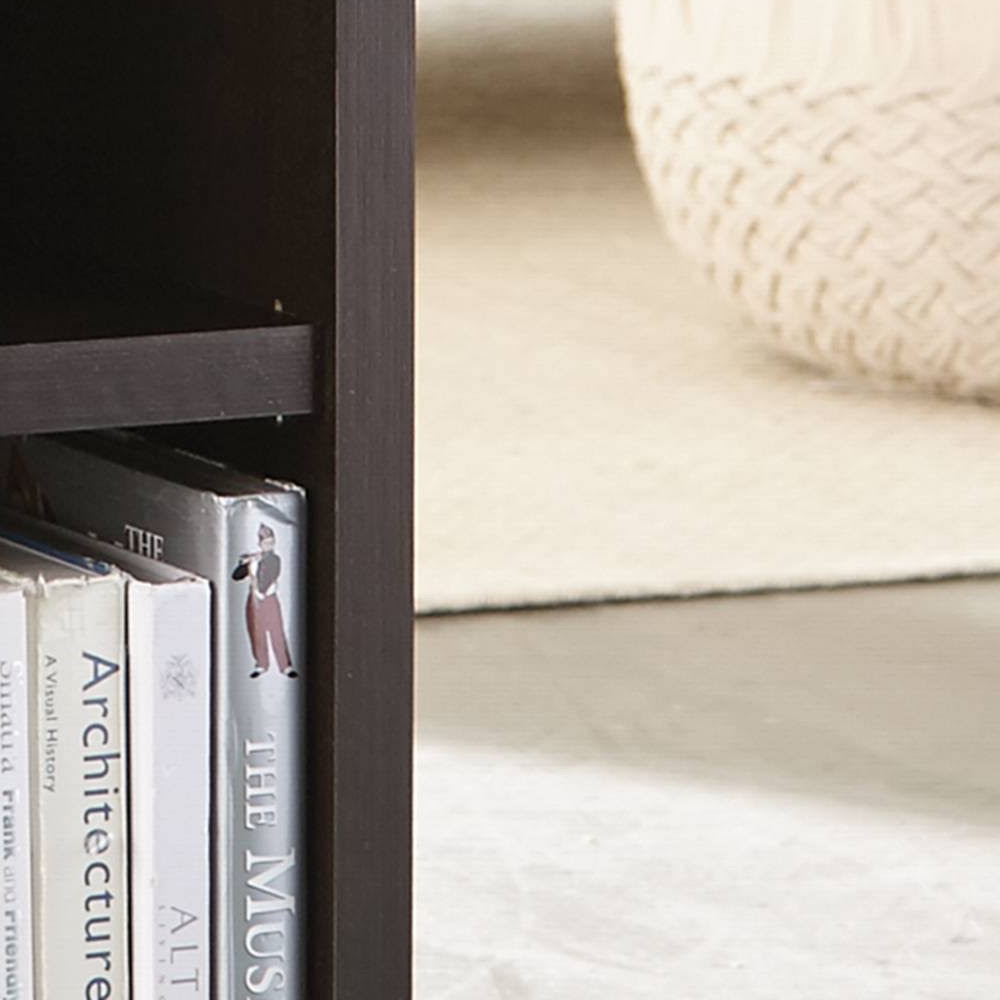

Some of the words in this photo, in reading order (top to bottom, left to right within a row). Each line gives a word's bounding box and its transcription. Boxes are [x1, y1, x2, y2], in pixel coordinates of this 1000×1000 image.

[124, 524, 165, 561] THE
[44, 673, 58, 722] Visual
[45, 655, 57, 667] A
[43, 729, 58, 793] History
[242, 732, 279, 831] THE
[81, 651, 121, 1000] Architecture
[1, 909, 24, 1000] Friendl
[243, 847, 296, 1000] MUS
